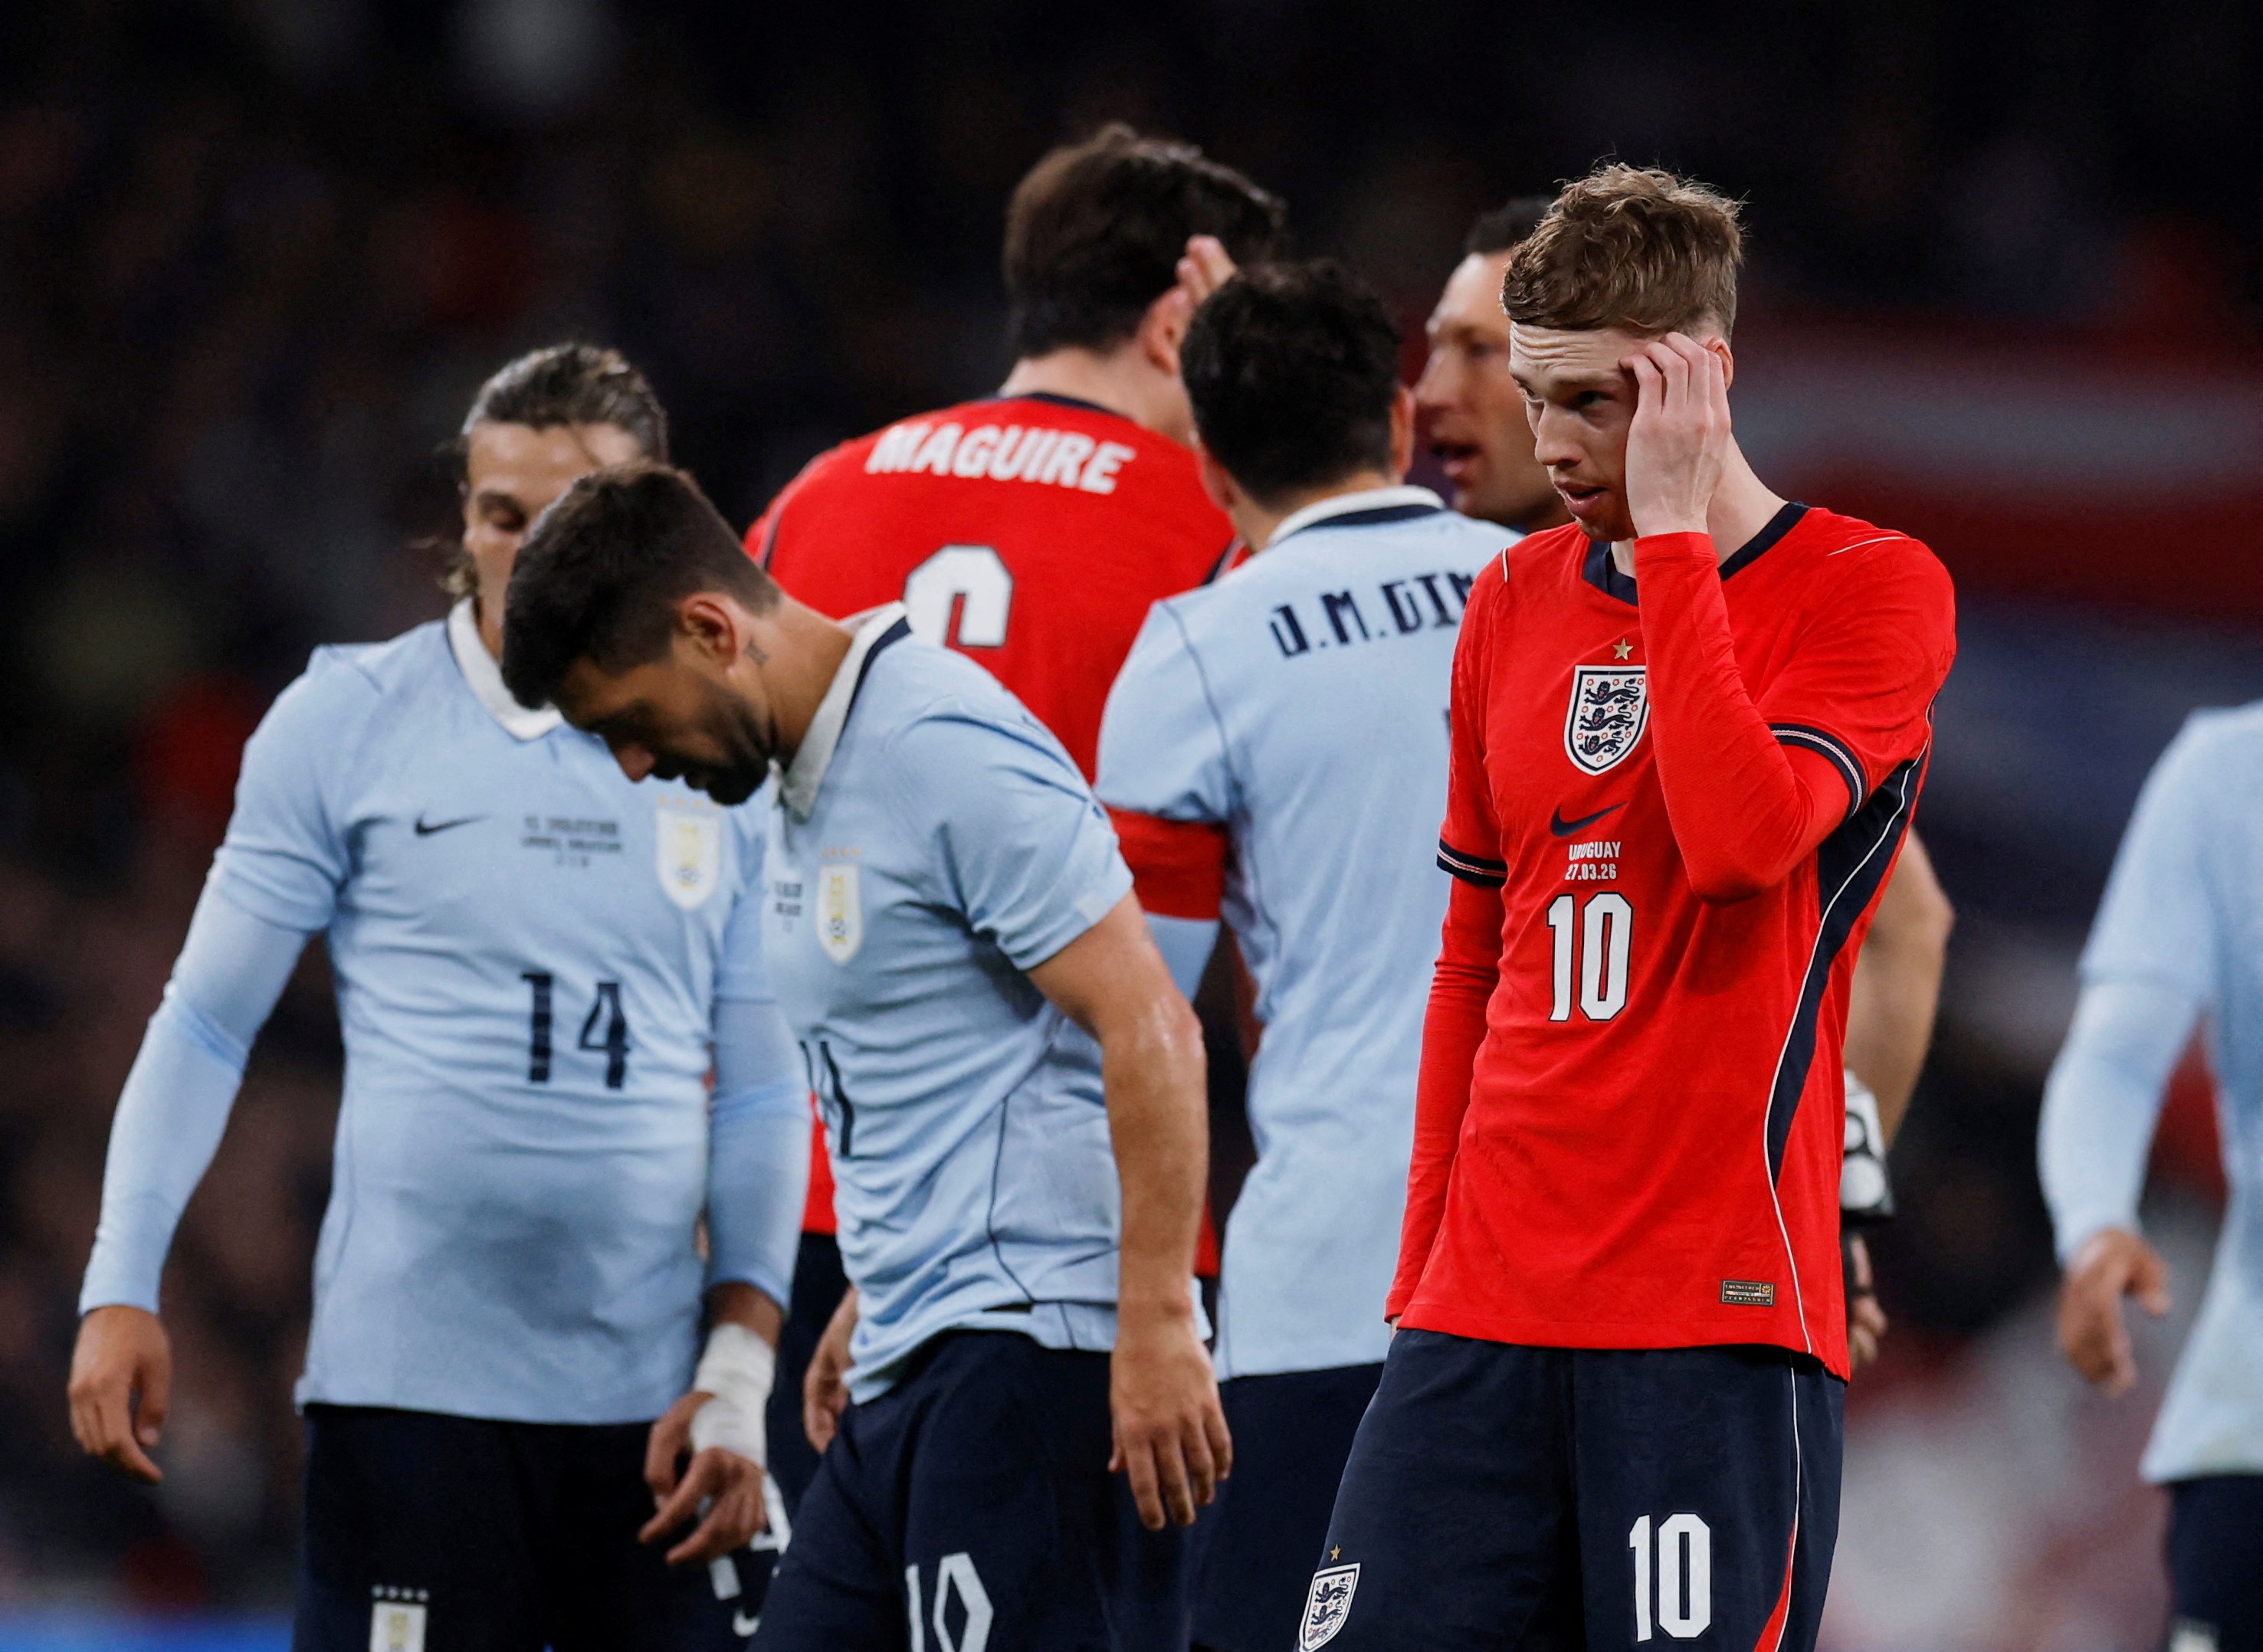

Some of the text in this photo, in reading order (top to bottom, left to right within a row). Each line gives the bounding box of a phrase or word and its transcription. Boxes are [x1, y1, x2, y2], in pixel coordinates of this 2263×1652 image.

[864, 422, 1137, 495] MAGUIRE
[1564, 863, 1617, 880] 27.03.26
[1568, 841, 1622, 860] URUGUAY
[1546, 890, 1635, 1022] 10
[520, 972, 631, 1090] 14
[1627, 1512, 1713, 1644] 10
